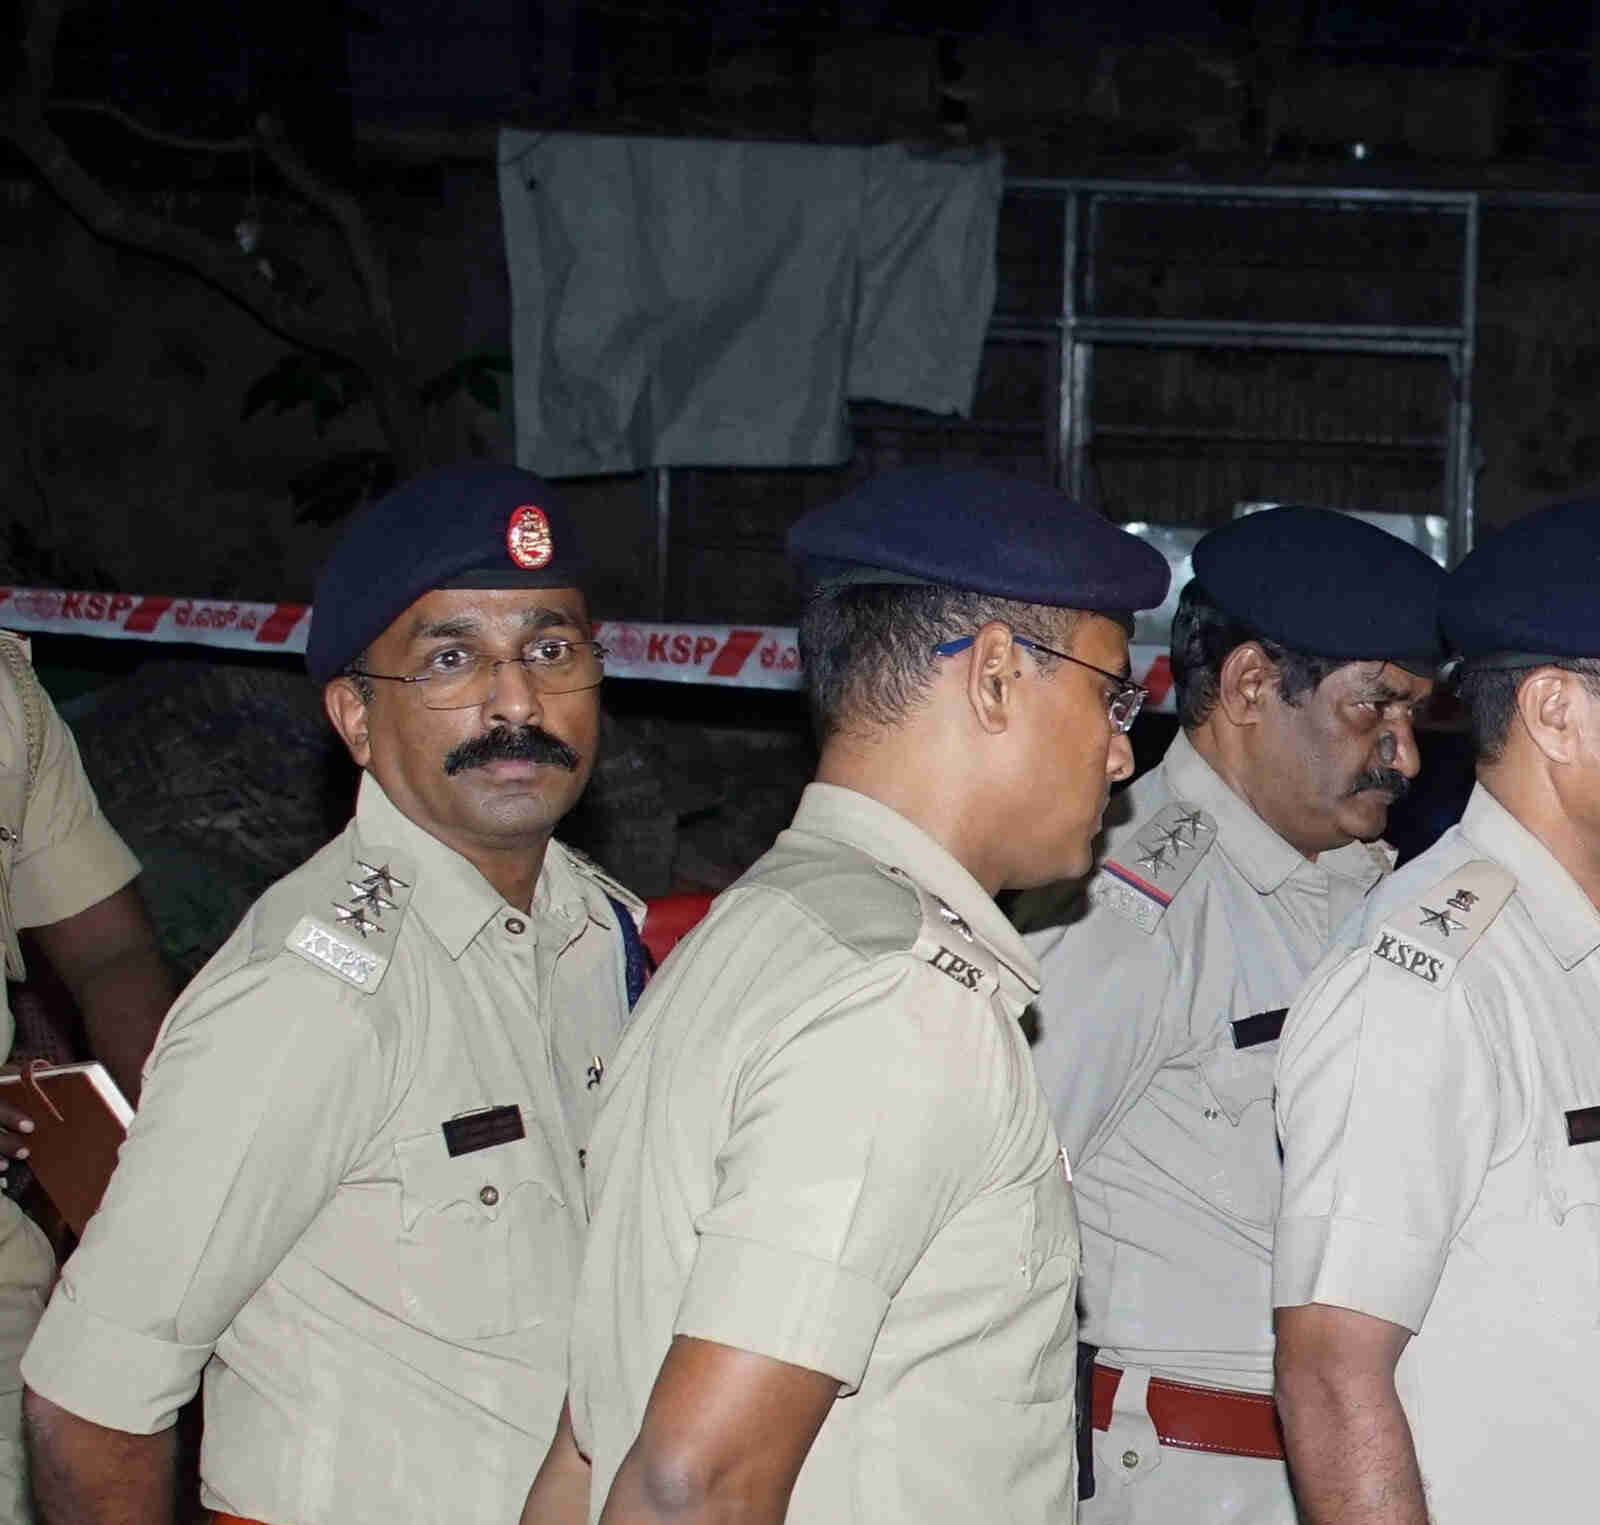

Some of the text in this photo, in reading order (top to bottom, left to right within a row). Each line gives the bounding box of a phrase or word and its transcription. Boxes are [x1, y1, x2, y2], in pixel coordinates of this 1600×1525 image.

[62, 591, 133, 622] KSP
[647, 632, 718, 665] KSP
[1374, 932, 1444, 982] KSPS
